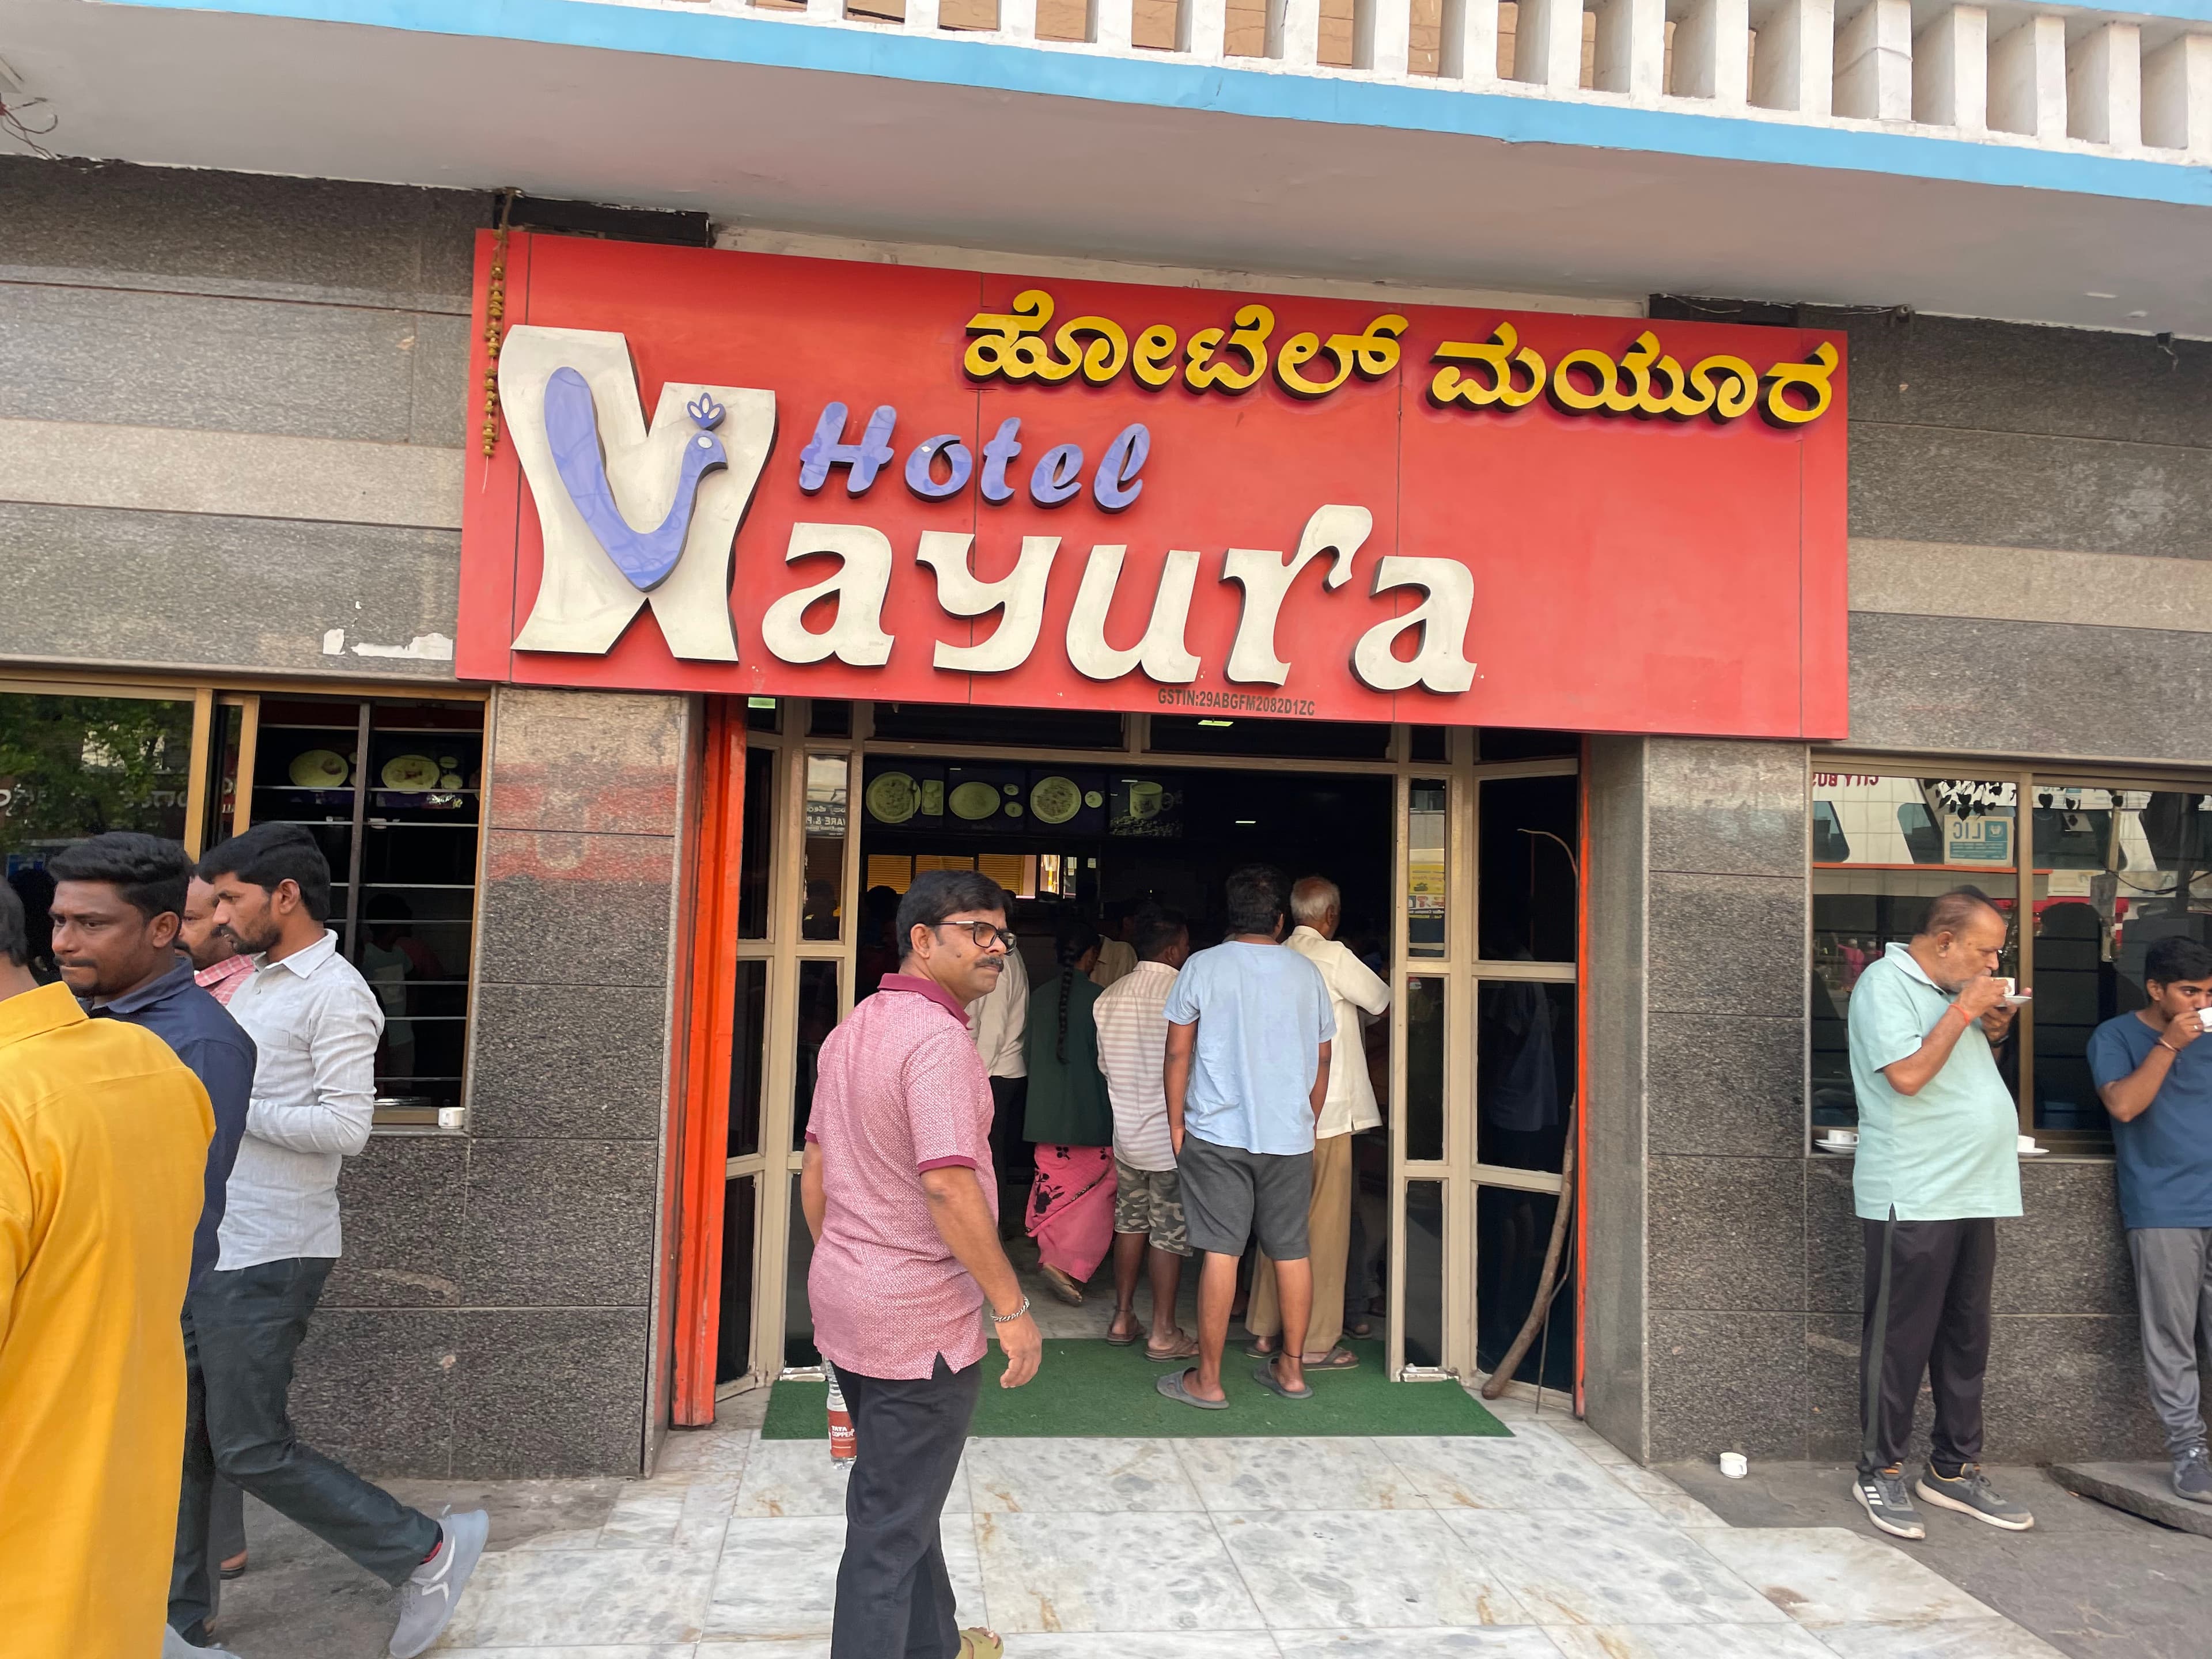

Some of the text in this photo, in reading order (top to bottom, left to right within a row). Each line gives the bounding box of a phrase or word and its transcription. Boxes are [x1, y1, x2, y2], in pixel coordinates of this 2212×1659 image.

[963, 289, 1838, 426] ಹೋಟೆಲ್ ಮಯೂರ
[498, 324, 1477, 695] Mayura
[800, 401, 1151, 512] Hotel
